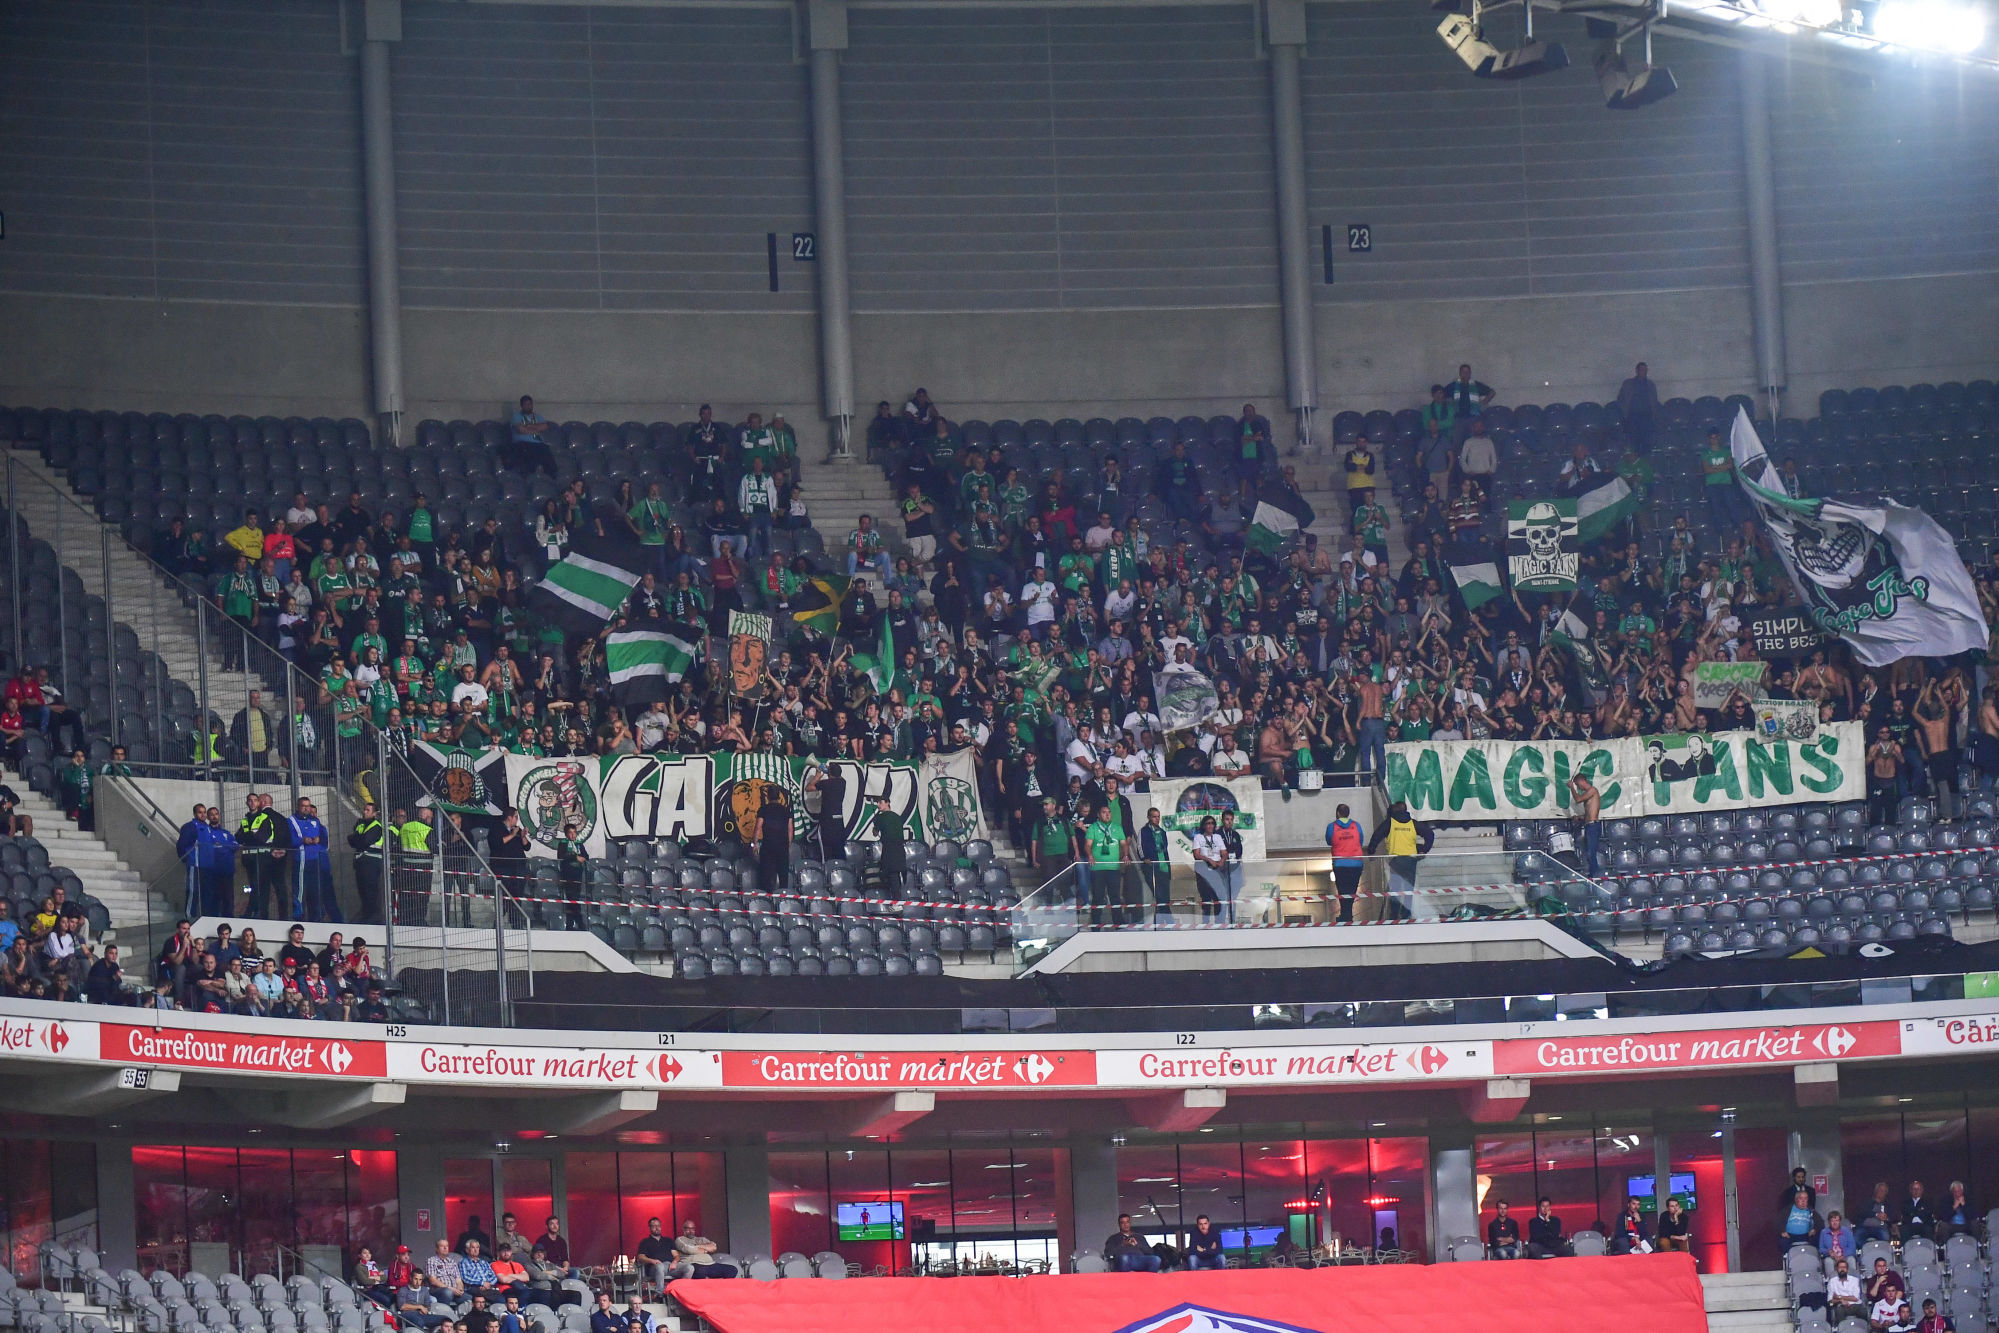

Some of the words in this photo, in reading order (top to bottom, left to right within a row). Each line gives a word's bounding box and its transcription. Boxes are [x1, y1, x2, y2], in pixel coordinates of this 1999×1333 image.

[795, 237, 814, 257] 22
[1350, 228, 1370, 249] 23
[1513, 556, 1548, 585] MAGIC
[1752, 617, 1815, 637] SIMPL
[1756, 636, 1795, 652] THE
[1798, 632, 1835, 650] BEST
[1386, 745, 1622, 812] MAGIC
[602, 755, 714, 841] GA
[0, 1019, 35, 1051] ket
[386, 1025, 406, 1037] H25
[128, 1028, 227, 1062] Carrefour
[232, 1039, 315, 1071] market
[1139, 1050, 1278, 1079] Carrefour
[1286, 1047, 1399, 1077] market
[1536, 1038, 1681, 1068] Carrefour
[1689, 1029, 1805, 1061] market
[124, 1070, 135, 1085] 55
[136, 1071, 147, 1086] 55
[420, 1047, 536, 1077] Carrefour
[543, 1052, 639, 1082] market
[760, 1055, 892, 1081] Carrefour
[900, 1055, 1007, 1085] market
